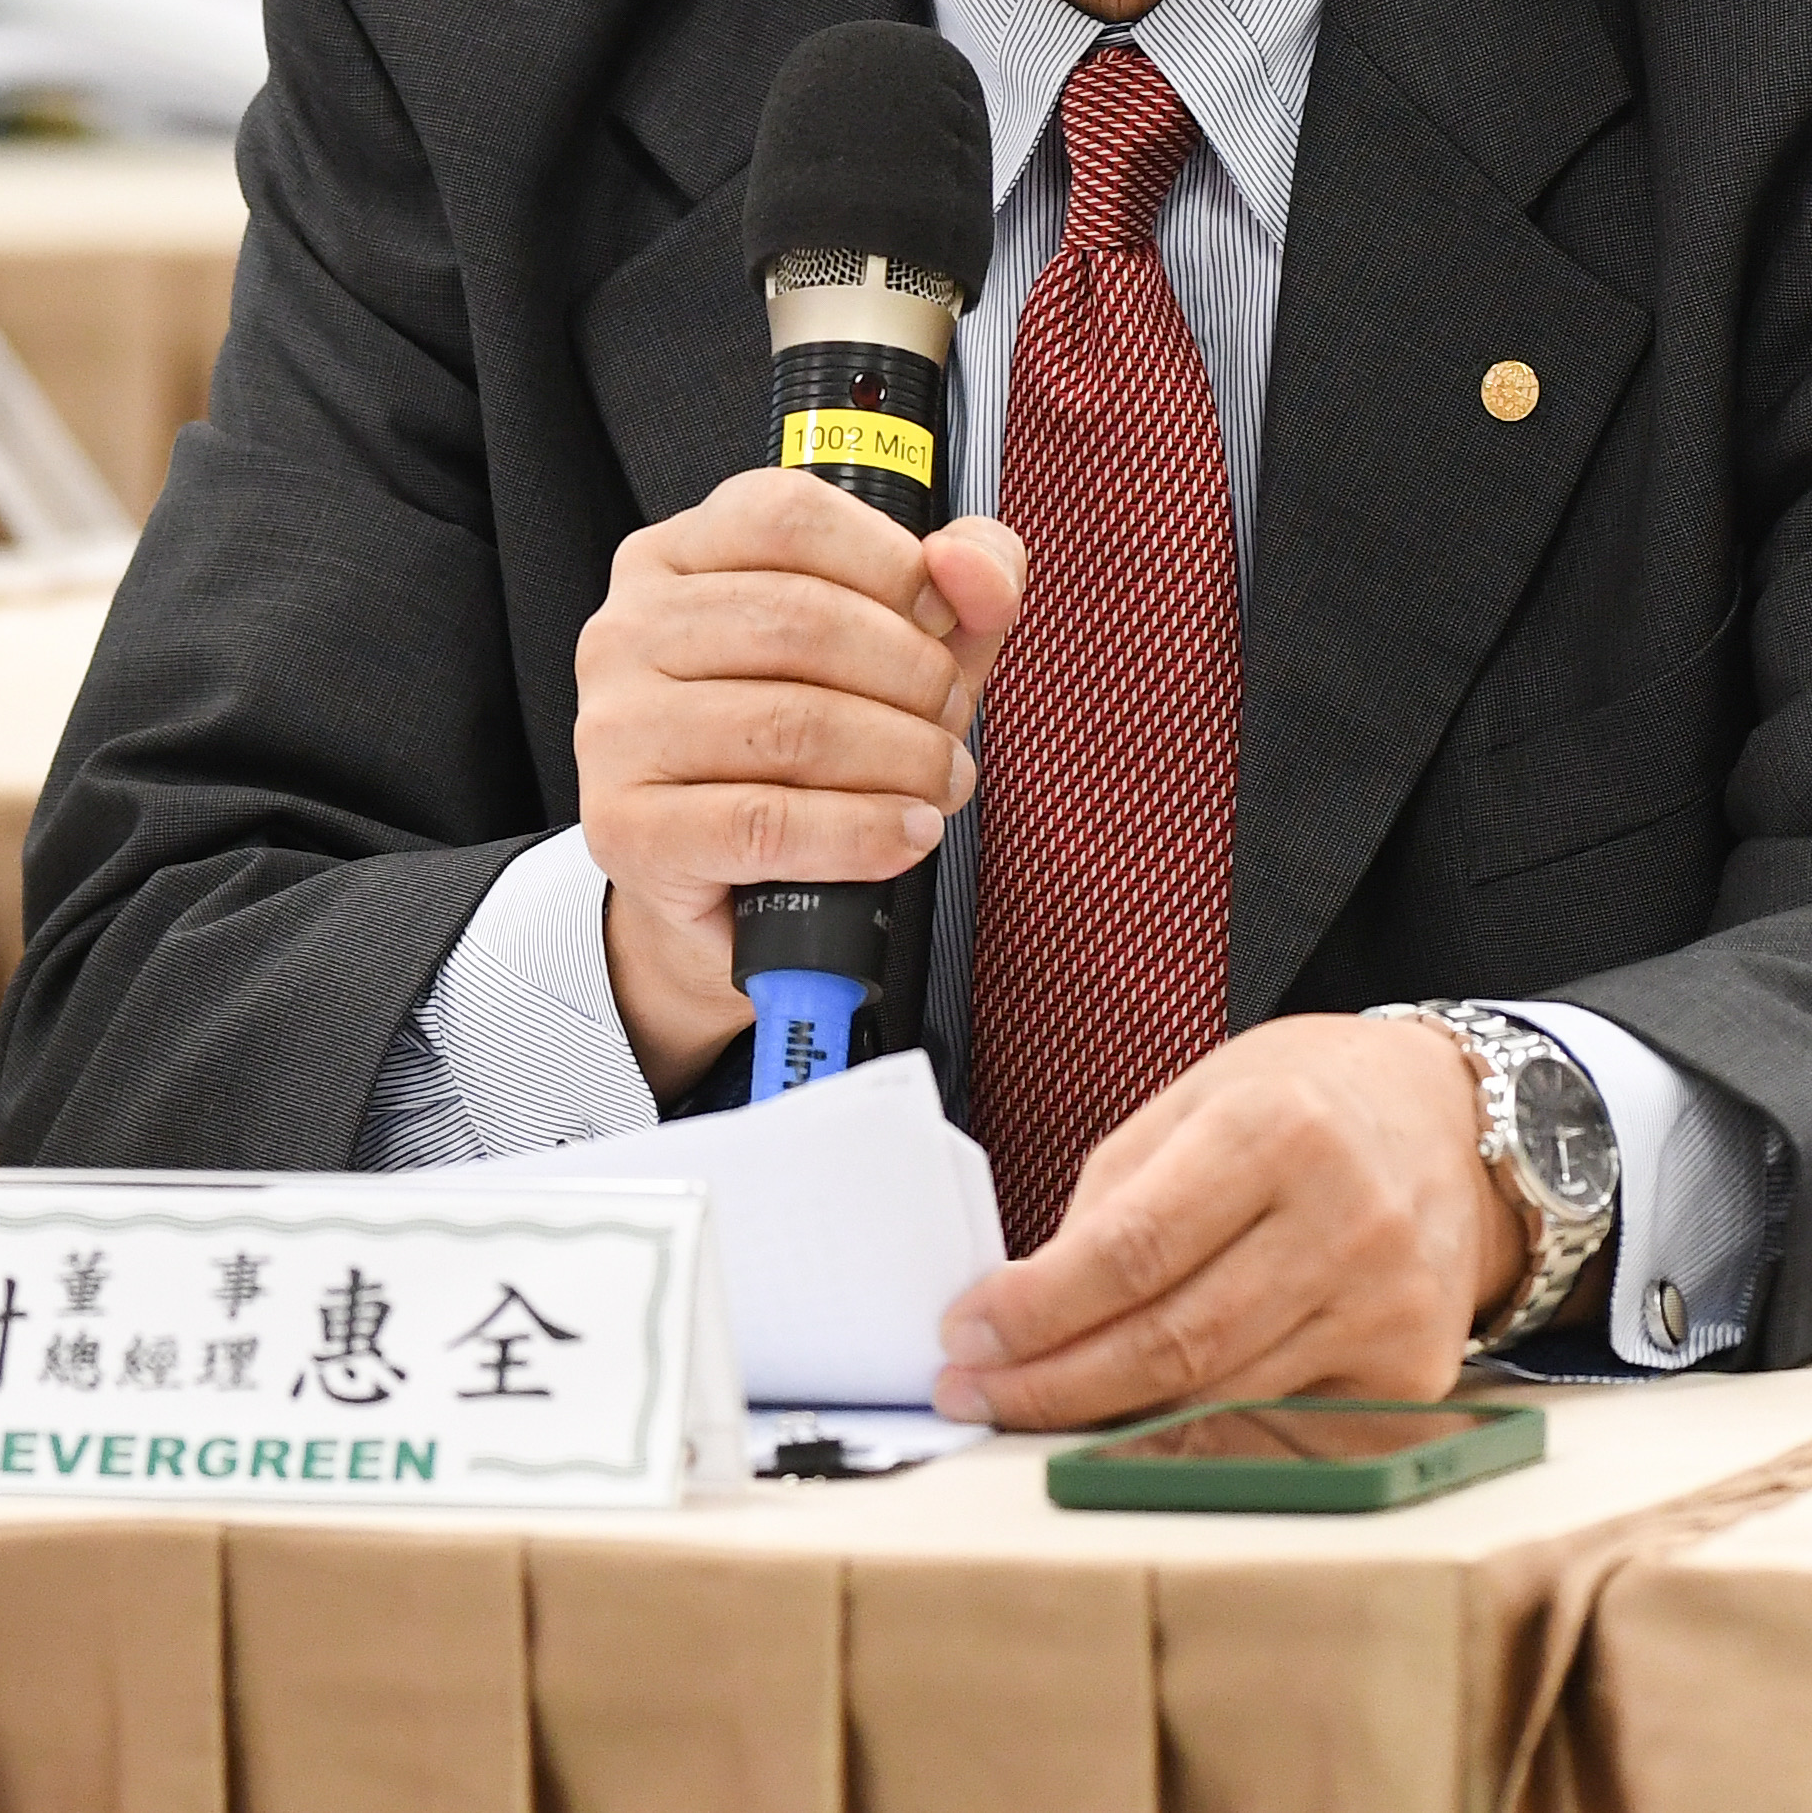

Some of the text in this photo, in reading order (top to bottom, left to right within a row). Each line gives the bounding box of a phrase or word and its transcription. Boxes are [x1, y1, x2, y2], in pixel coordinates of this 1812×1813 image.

[794, 425, 927, 470] 1002 Mic1
[0, 1430, 438, 1481] EVERGREEN
